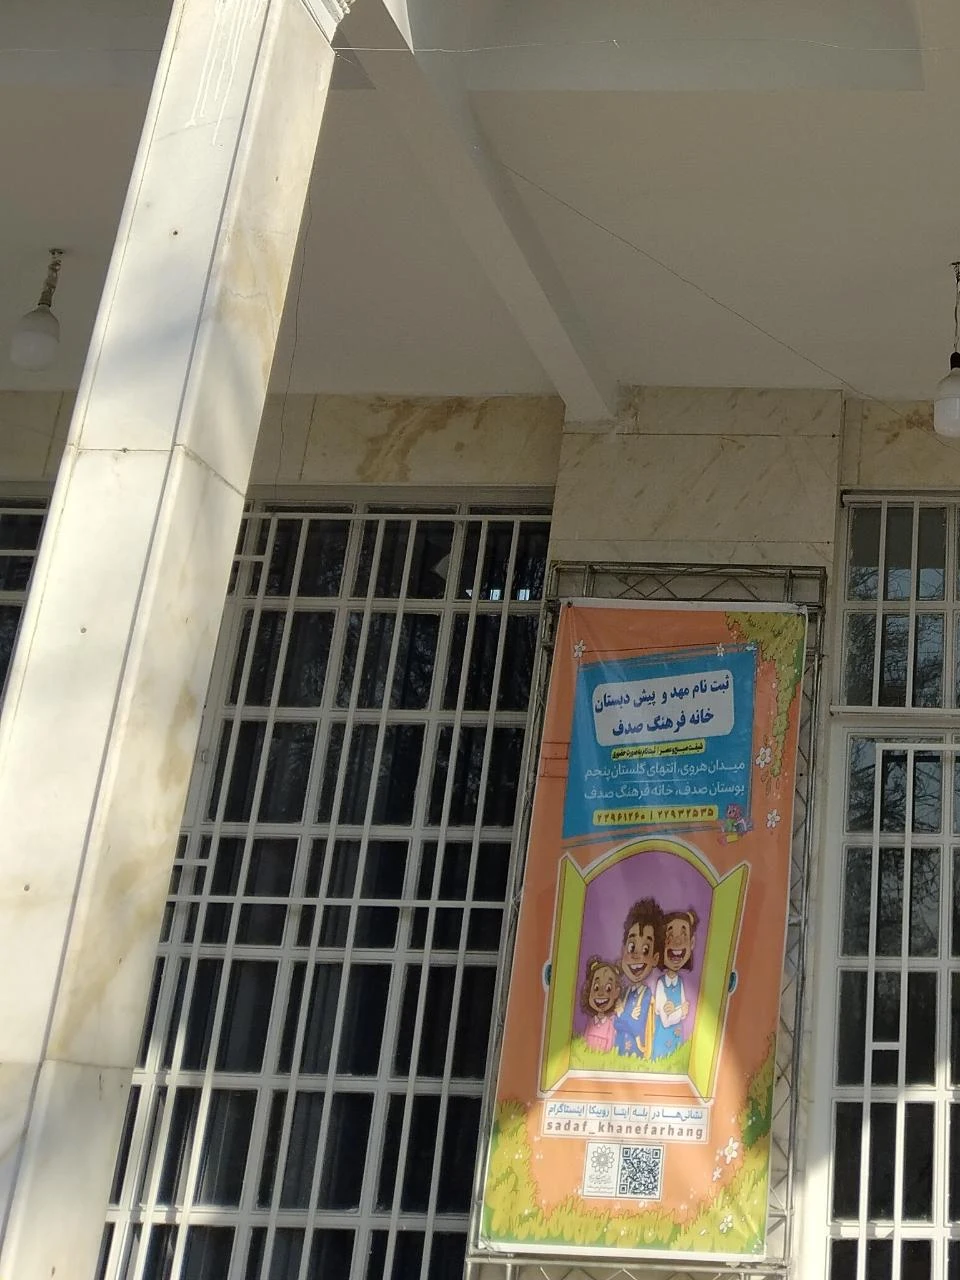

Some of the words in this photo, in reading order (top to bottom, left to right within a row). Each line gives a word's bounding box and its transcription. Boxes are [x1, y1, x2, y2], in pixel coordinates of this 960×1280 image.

[692, 679, 708, 698] نام
[710, 675, 729, 693] ثبت
[633, 690, 656, 708] پیش
[661, 690, 668, 704] و
[670, 686, 690, 699] مهد
[594, 692, 630, 713] دبستان
[646, 711, 687, 734] فرهنگ
[689, 708, 714, 725] خانه
[612, 720, 644, 737] صدف
[584, 767, 612, 780] پنجم
[611, 762, 647, 778] گلستان
[646, 763, 677, 777] انتهای
[708, 759, 745, 774] میدان
[584, 789, 614, 800] صدف
[615, 785, 650, 800] فرهنگ
[650, 784, 674, 796] خانه
[709, 781, 745, 796] بوستان
[548, 1103, 585, 1116] اینستاگرام
[588, 1104, 610, 1119] روبیکا
[632, 1107, 648, 1118] بله
[652, 1108, 660, 1120] در
[547, 1119, 704, 1140] sadaf_khanefarhang
